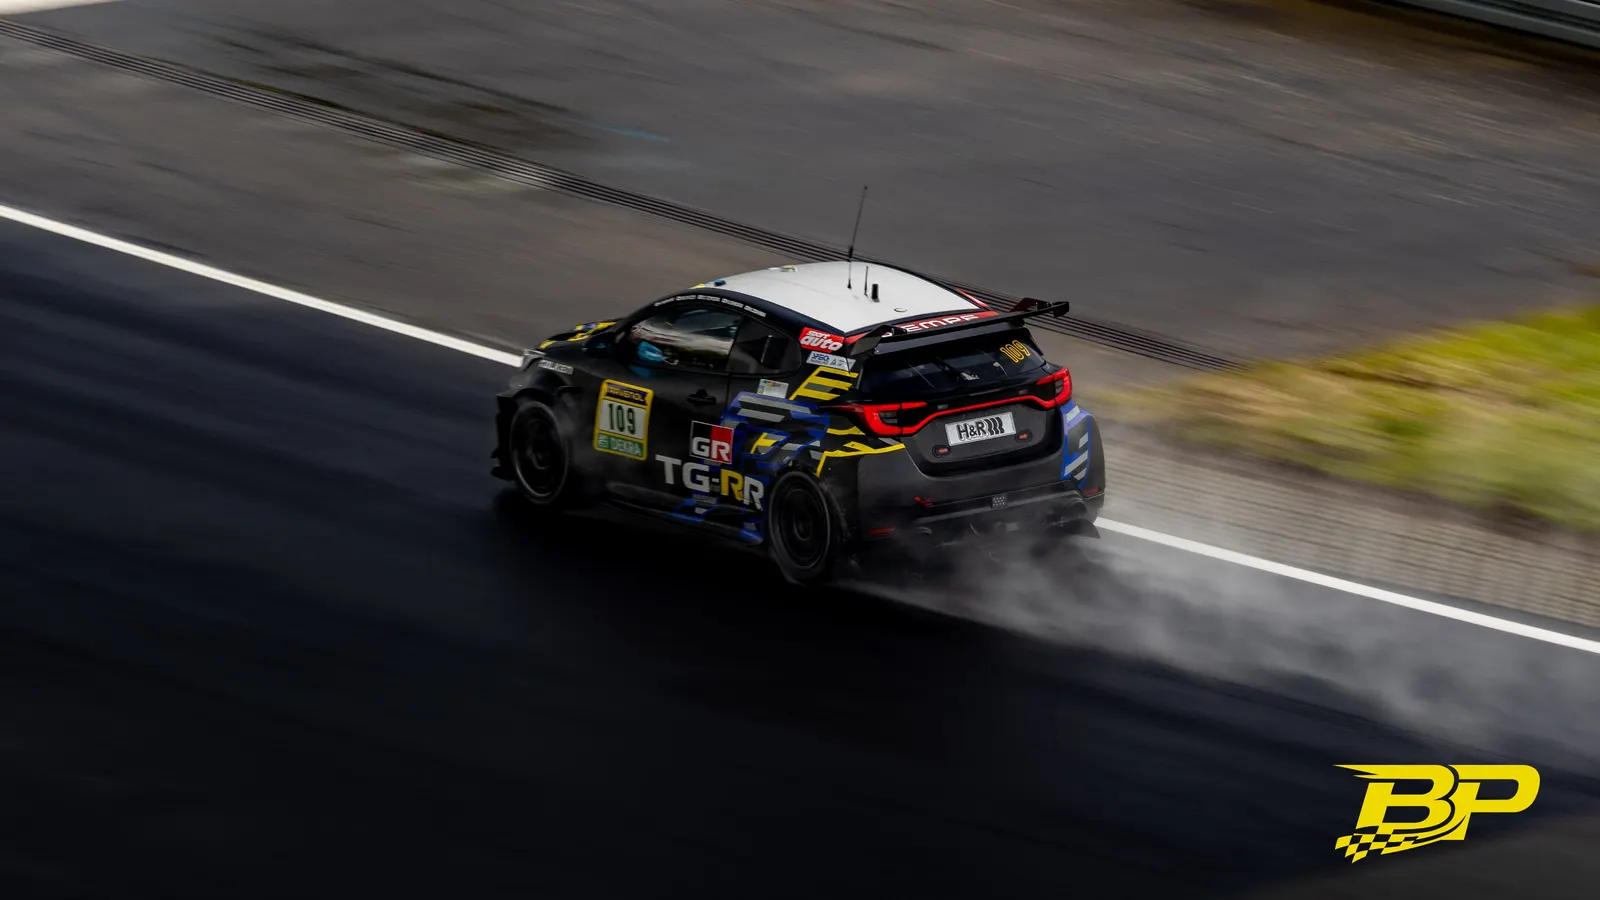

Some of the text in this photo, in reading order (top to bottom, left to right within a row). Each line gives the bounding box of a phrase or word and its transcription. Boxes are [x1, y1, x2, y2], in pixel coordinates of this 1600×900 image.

[800, 335, 843, 351] auto
[999, 339, 1031, 363] 109
[608, 403, 636, 434] 109
[691, 436, 730, 462] GR
[655, 454, 764, 511] TG-RR
